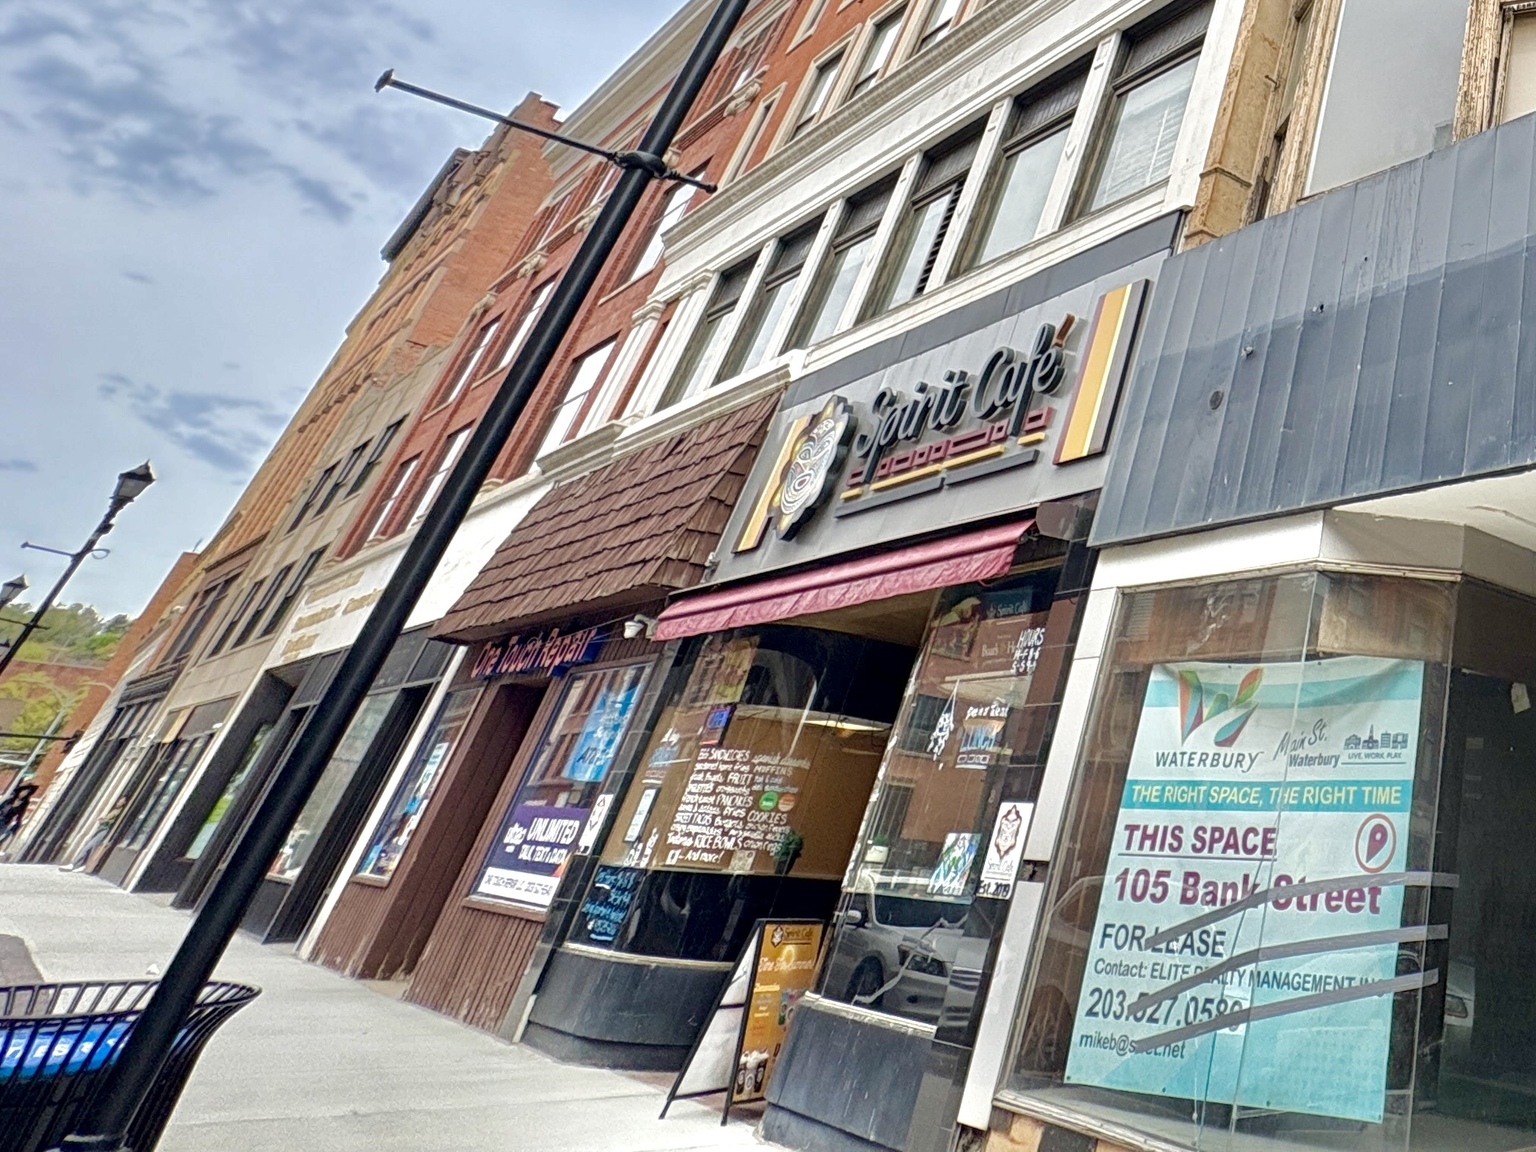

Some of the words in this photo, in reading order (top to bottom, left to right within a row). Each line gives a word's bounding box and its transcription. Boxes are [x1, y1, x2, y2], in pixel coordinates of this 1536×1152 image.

[854, 370, 970, 484] Spirit
[971, 313, 1076, 436] Café
[1017, 628, 1046, 649] HOURS
[1273, 732, 1308, 761] Main
[1288, 752, 1341, 769] Waterbury
[1155, 750, 1260, 774] WATERBURY
[1132, 785, 1162, 803] THE
[1164, 785, 1207, 803] RIGHT
[1209, 786, 1263, 807] SPACE,
[1268, 786, 1299, 805] THE
[1303, 786, 1358, 805] RIGHT
[1361, 786, 1402, 805] TIME
[526, 817, 580, 845] UNLIMITED
[1124, 824, 1184, 853] THIS
[1191, 825, 1277, 856] SPACE
[1114, 867, 1171, 904] 105
[1180, 870, 1260, 908] Bank
[1270, 873, 1382, 914] Street
[1099, 923, 1148, 952] FOR
[1151, 926, 1226, 958] LEASE
[1094, 958, 1148, 979] Contact:
[1150, 962, 1191, 981] ELITE
